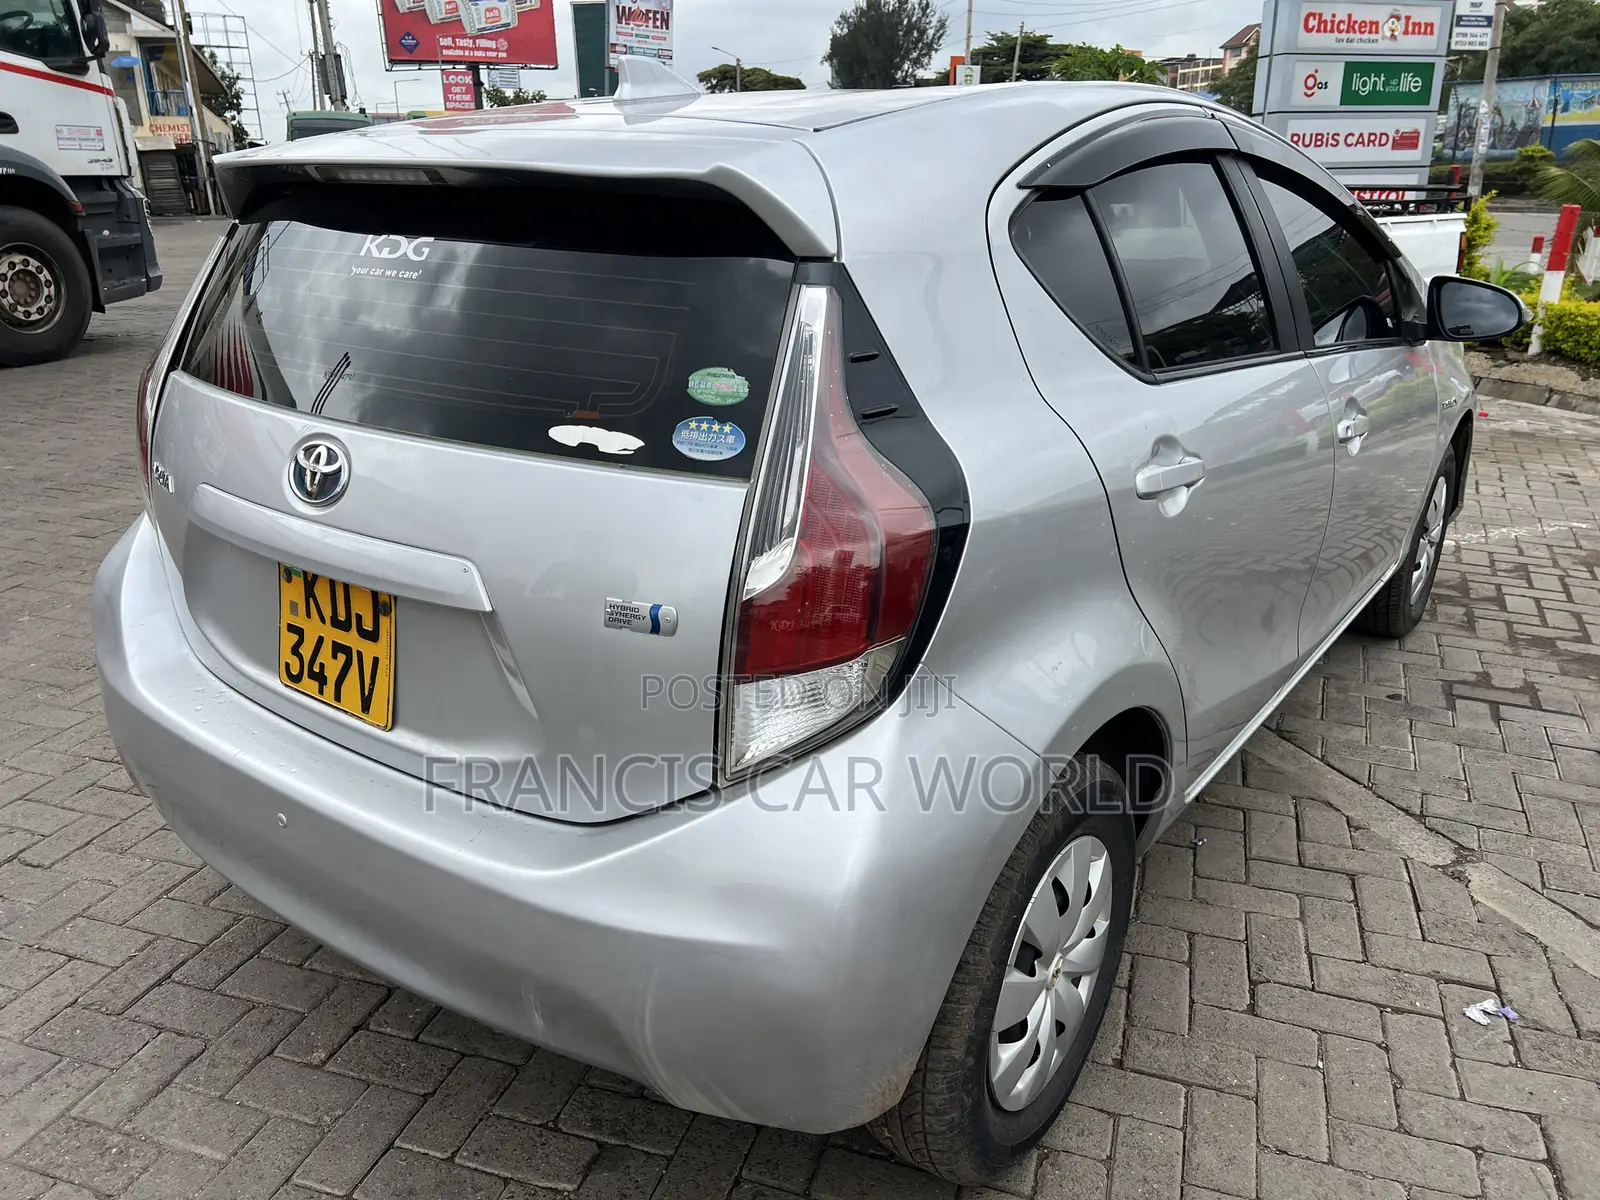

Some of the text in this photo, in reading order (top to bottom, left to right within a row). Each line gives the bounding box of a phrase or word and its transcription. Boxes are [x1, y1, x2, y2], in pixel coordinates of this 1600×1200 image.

[1303, 12, 1435, 36] Chicken Inn
[443, 75, 472, 84] LOOK
[1303, 69, 1329, 98] gas
[1352, 72, 1386, 96] light
[1400, 72, 1422, 93] life
[149, 124, 190, 132] CHEMIST
[1344, 132, 1390, 147] CARD
[360, 234, 435, 262] KDG
[370, 268, 384, 276] car
[385, 269, 397, 277] we
[302, 570, 380, 644] KDJ
[609, 603, 640, 614] HYBRID
[606, 610, 647, 621] SYNERGY
[608, 617, 633, 626] DRIVE
[284, 622, 380, 715] 347V
